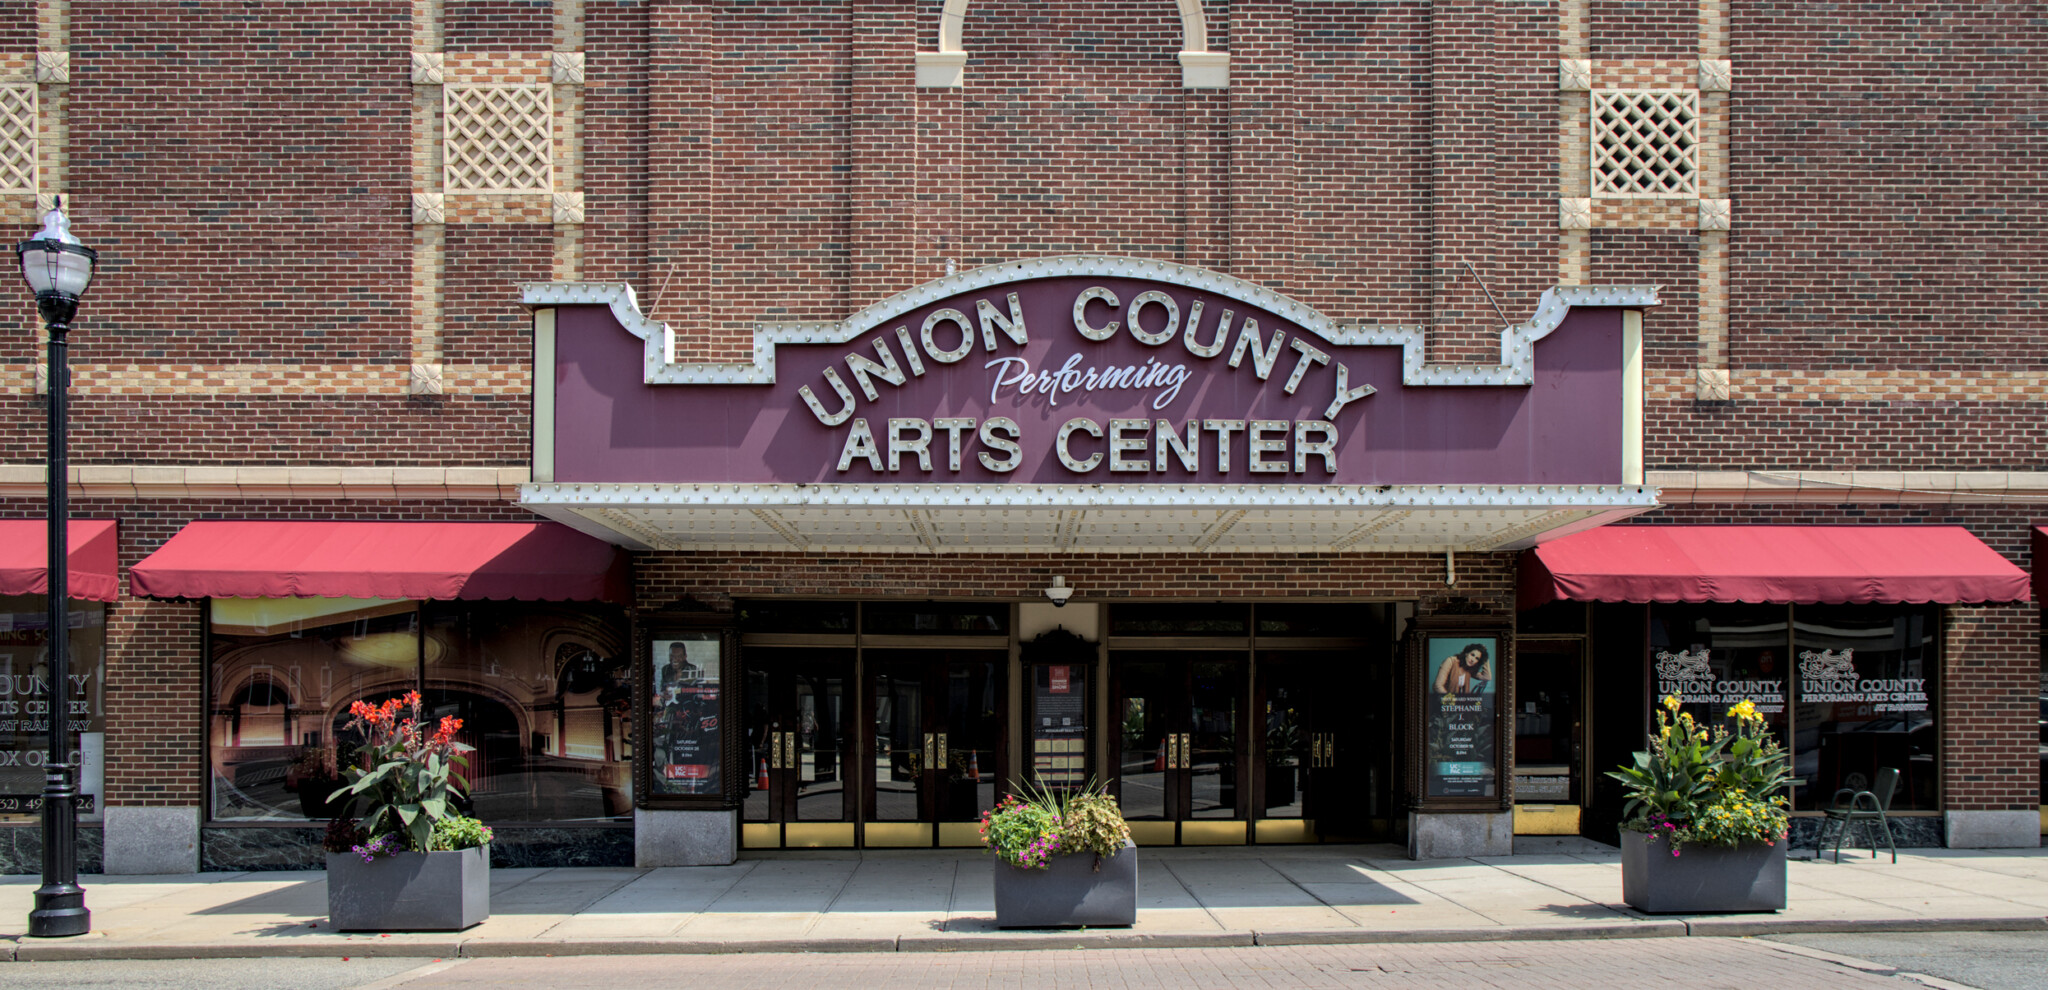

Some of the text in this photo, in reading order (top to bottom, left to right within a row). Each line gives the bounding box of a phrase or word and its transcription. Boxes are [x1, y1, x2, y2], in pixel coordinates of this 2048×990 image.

[798, 286, 1378, 427] UNION COUNTY
[984, 353, 1192, 410] Performing
[836, 416, 1338, 473] ARTS CENTER
[0, 674, 90, 695] OUNY
[1658, 680, 1782, 694] UNION COUNTY
[1802, 679, 1926, 693] UNION COUNTY
[1658, 694, 1784, 703] PORMING ARTS CENTER
[1801, 692, 1929, 703] PERFORMING ARTS CENTER
[25, 700, 91, 714] CEER
[20, 720, 91, 731] RAAY
[1449, 723, 1474, 731] BLOCK
[0, 750, 92, 766] OX OFCE
